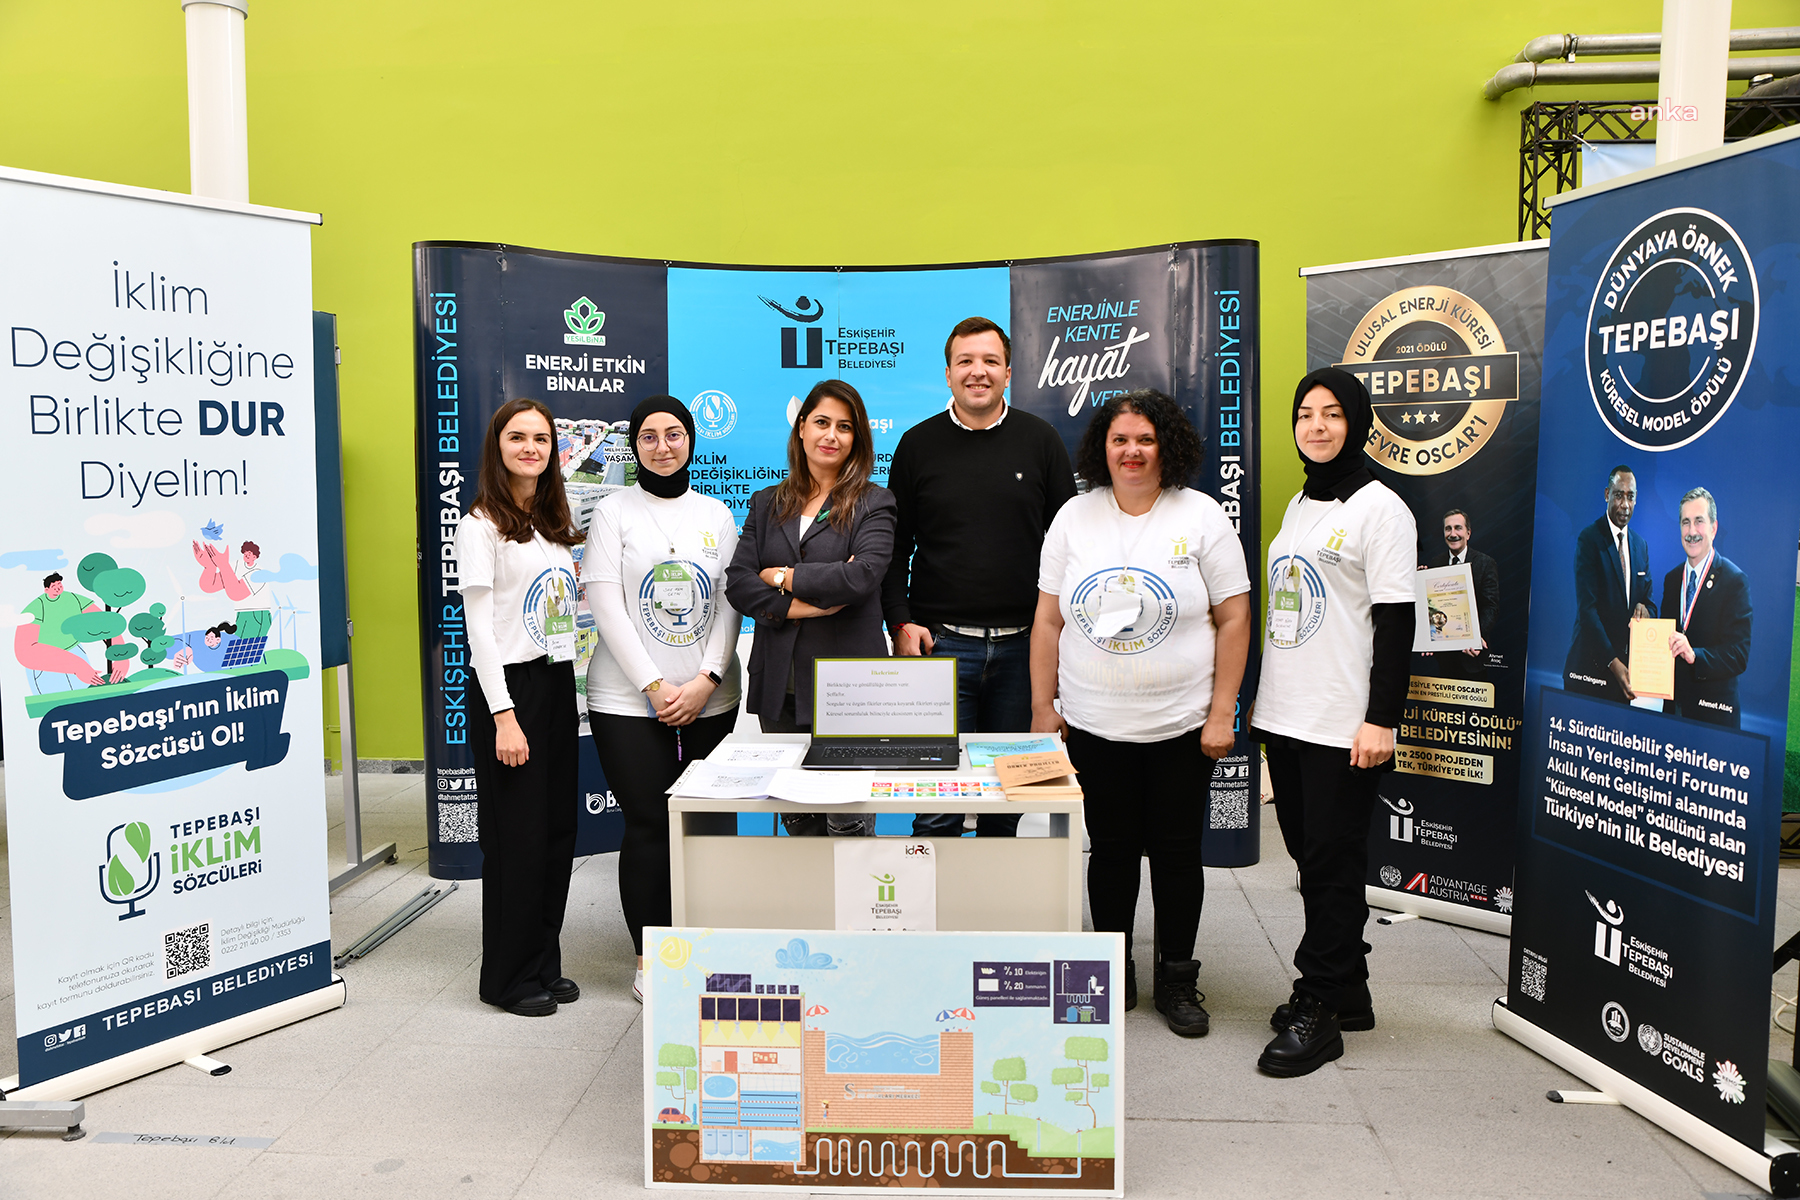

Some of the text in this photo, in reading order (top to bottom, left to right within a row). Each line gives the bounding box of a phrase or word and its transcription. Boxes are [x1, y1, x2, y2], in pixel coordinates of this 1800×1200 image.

[1603, 224, 1739, 311] DÜNYAYA ÖRNEK
[113, 260, 208, 315] İklim
[1047, 298, 1140, 323] ENERJİNLE
[838, 327, 896, 340] ESKİŞEHİR
[1065, 322, 1122, 343] KENTE
[1354, 296, 1495, 358] ULUSAL ENERJİ KÜRESİ
[1598, 308, 1740, 356] TEPEBAŞI
[11, 326, 294, 386] Değişikliğine
[525, 352, 646, 374] ENERJİ ETKİN
[825, 340, 904, 357] TEPEBAŞI
[838, 358, 896, 369] BELEDİYESİ
[1395, 341, 1447, 354] 2021 ÖDÜLÜ
[430, 292, 460, 453] BELEDİYESİ
[546, 372, 625, 393] BİNALAR
[1038, 326, 1150, 417] hayat
[1214, 290, 1241, 447] BELEDİYESİ
[1353, 364, 1491, 398] TEPEBAŞI
[1600, 356, 1733, 432] KÜRESEL MODEL ÖDÜLÜ
[30, 394, 286, 436] Birlikte DUR
[1416, 414, 1488, 466] OSCAR'I
[604, 454, 635, 463] YAŞAM
[691, 467, 789, 482] DEĞİŞİKLİĞİNE
[81, 458, 248, 508] Diyelim!
[691, 482, 750, 495] BİRLİKTE
[1075, 608, 1107, 645] TEPEBŞI
[438, 604, 469, 745] ESKİŞEHİR
[51, 686, 280, 744] Tepebaşı'nın İklim
[1422, 708, 1466, 726] KÜRESİ
[1698, 699, 1734, 714] Ahmet Ataç
[101, 721, 245, 769] Sözcüsü Ol!
[1400, 723, 1512, 751] BELEDİYESİNİN!
[1549, 716, 1751, 780] 14. Sürdürülebilir Şehirler ve
[1397, 750, 1484, 768] ve 2500 PROJEDEN
[1398, 760, 1484, 779] TEK, TÜRKİYE'DE İLK!
[1548, 731, 1749, 806] İnsan Yerleşimleri Forumu
[1547, 756, 1747, 830] Akıllı Kent Gelişimi alanında
[170, 806, 260, 839] TEPEBAŞI
[1413, 825, 1458, 844] TEPEBAŞI
[1646, 808, 1706, 843] ödülünü
[1709, 831, 1747, 856] alan
[1544, 796, 1745, 883] Türkiye'nin ilk Belediyesi
[173, 859, 263, 895] SÖZCÜLERİ
[1429, 875, 1488, 895] ADVANTAGE
[1429, 886, 1470, 902] AUSTRIA
[870, 907, 902, 915] TEPEBAŞI
[1622, 942, 1674, 979] TEPEBAŞI
[1630, 935, 1669, 962] ESKİŞEHİR
[57, 952, 155, 984] Kayıt olmak için QR kodu
[68, 960, 155, 992] telefonunuza okutarak
[1014, 968, 1023, 976] 10
[1628, 963, 1667, 989] BELEDİYESİ
[36, 999, 58, 1011] kayıt
[59, 989, 93, 1004] formunu
[102, 951, 314, 1031] TEPEBAŞI BELEDİYESİ
[1014, 982, 1024, 990] 20
[1663, 1032, 1706, 1061] SUSTAINABLE
[1663, 1041, 1705, 1068] DEVELOPMENT
[1662, 1050, 1705, 1083] GOALS
